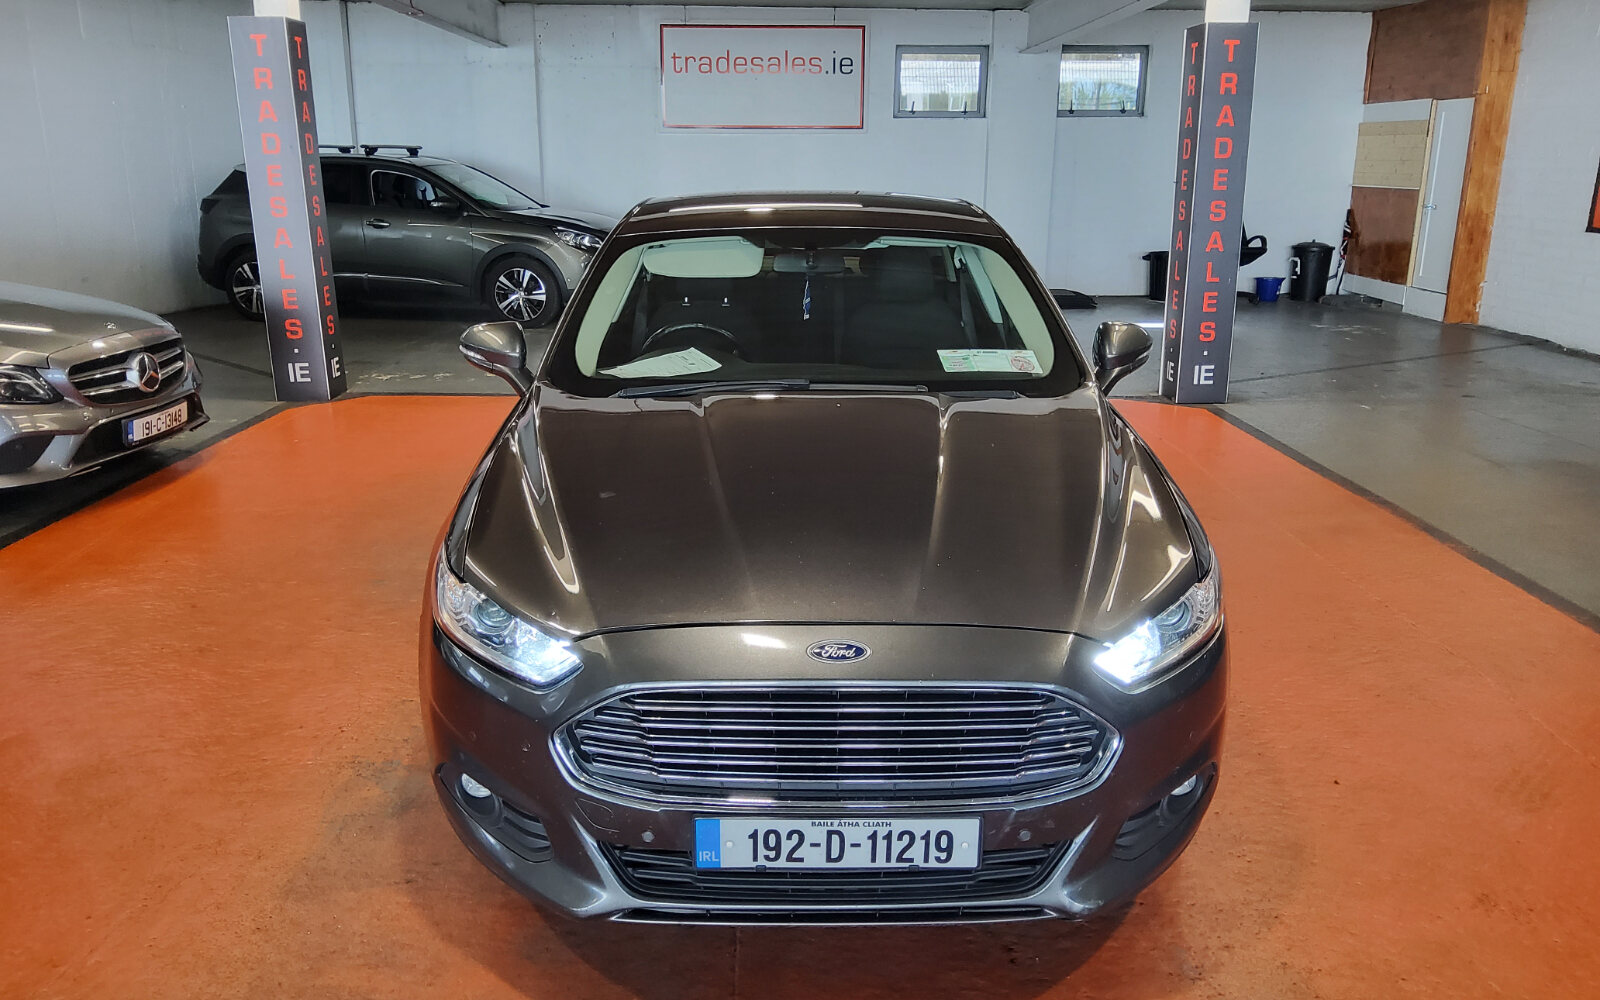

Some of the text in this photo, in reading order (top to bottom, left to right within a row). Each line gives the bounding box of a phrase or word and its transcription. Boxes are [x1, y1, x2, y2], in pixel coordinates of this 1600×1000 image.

[671, 49, 854, 75] tradesales.ie
[142, 408, 182, 437] 191-C-13148
[813, 644, 857, 658] Ford
[699, 850, 719, 862] IRL
[747, 828, 955, 864] 192-D-11219
